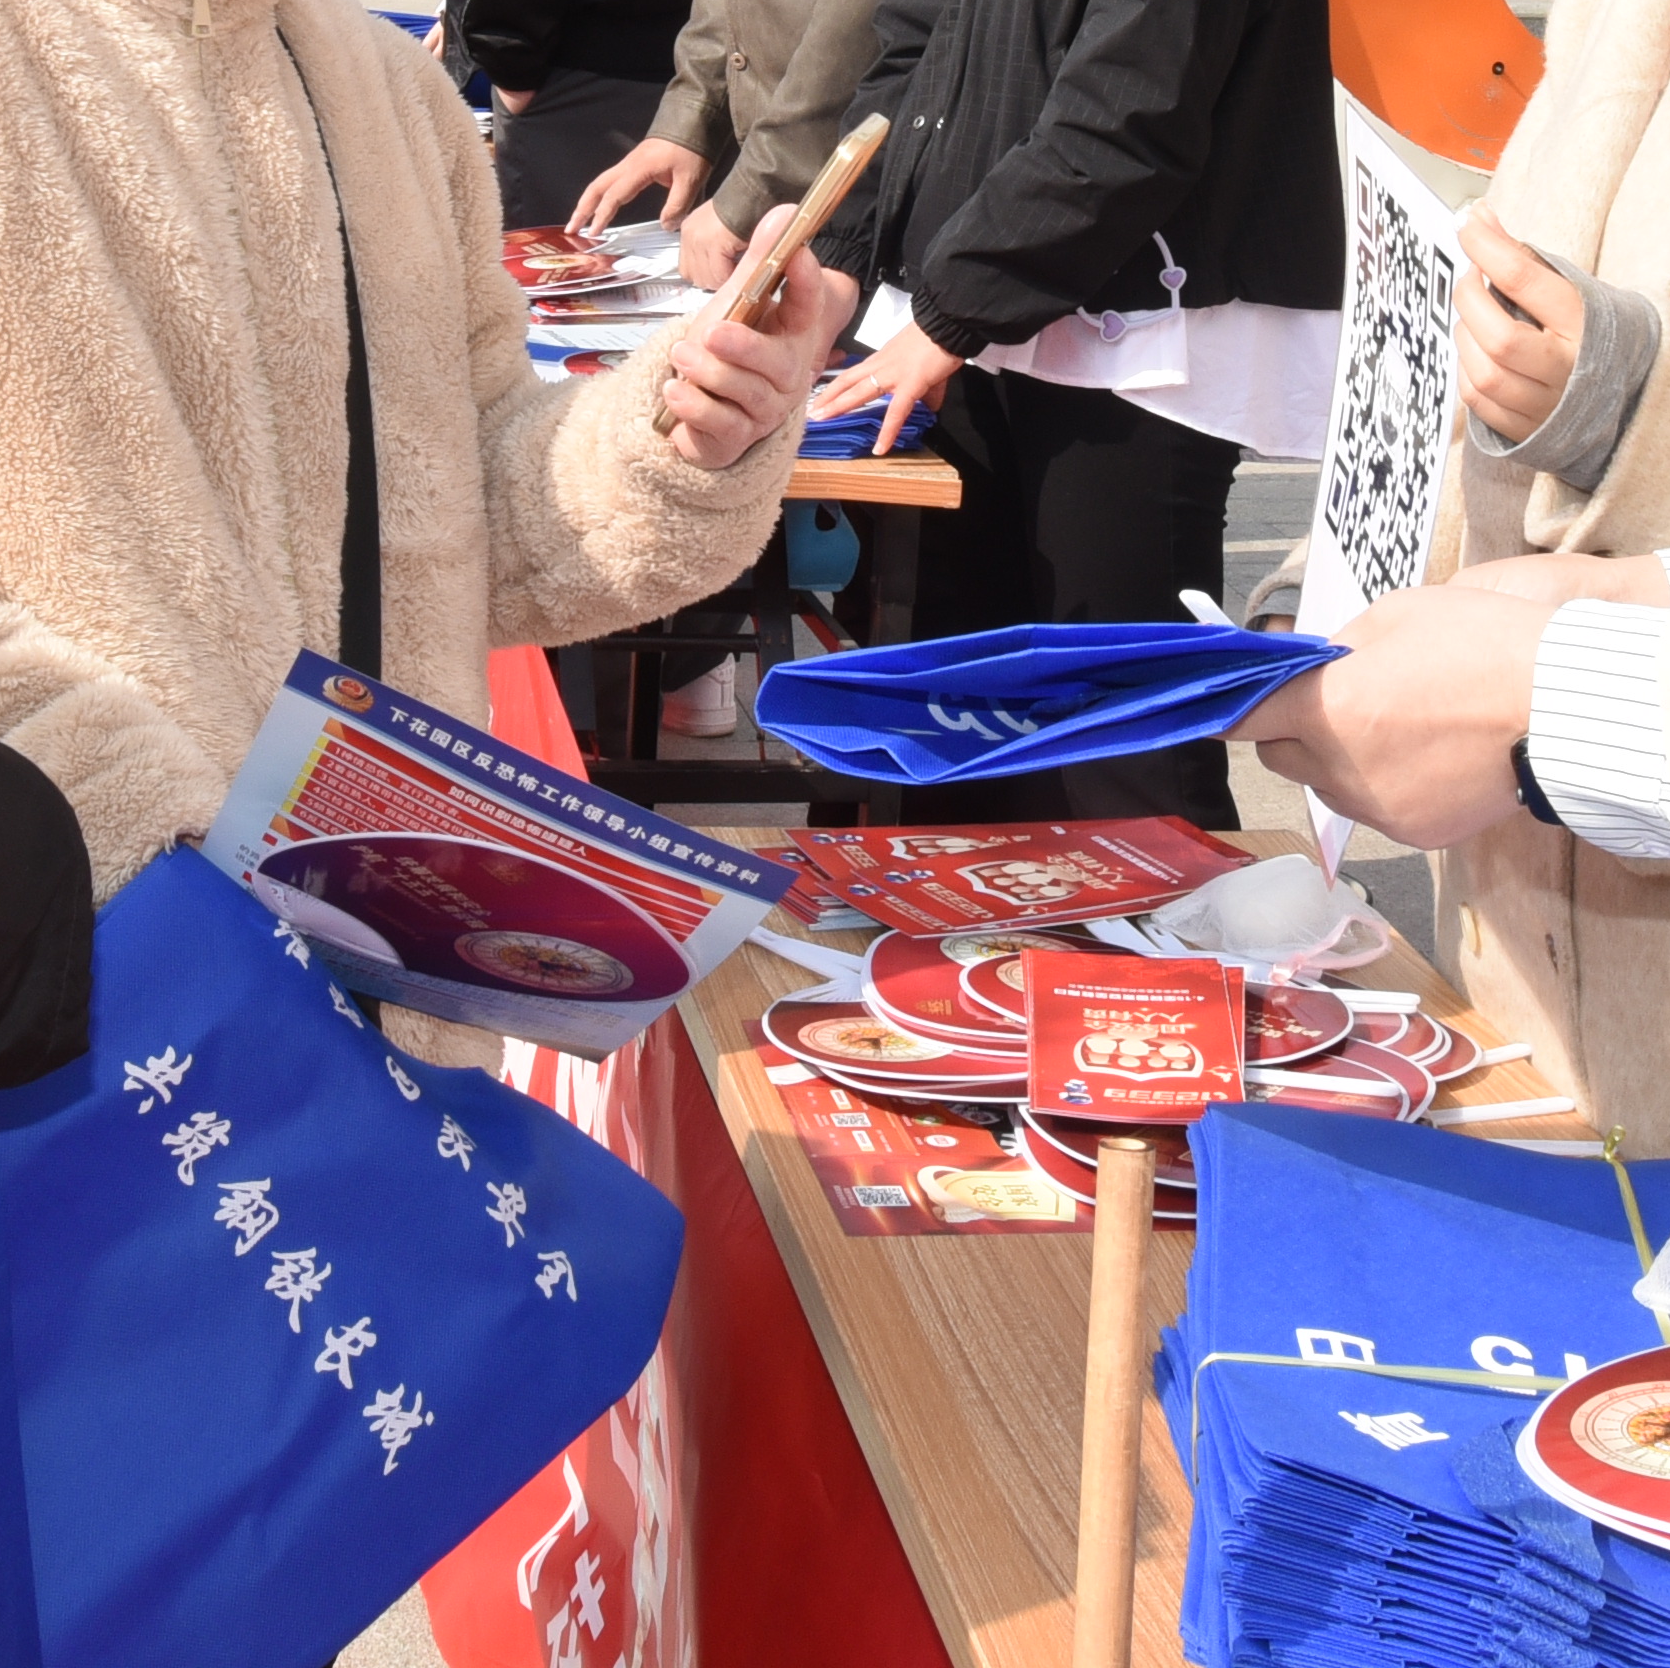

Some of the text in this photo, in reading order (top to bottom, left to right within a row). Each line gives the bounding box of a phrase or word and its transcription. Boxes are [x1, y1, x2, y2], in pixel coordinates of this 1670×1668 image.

[389, 705, 761, 885] 下花园区反恐怖工作领导小组宣传资料
[447, 785, 588, 857] 如何识别恐怖嫌疑人
[1102, 1087, 1213, 1101] 12339
